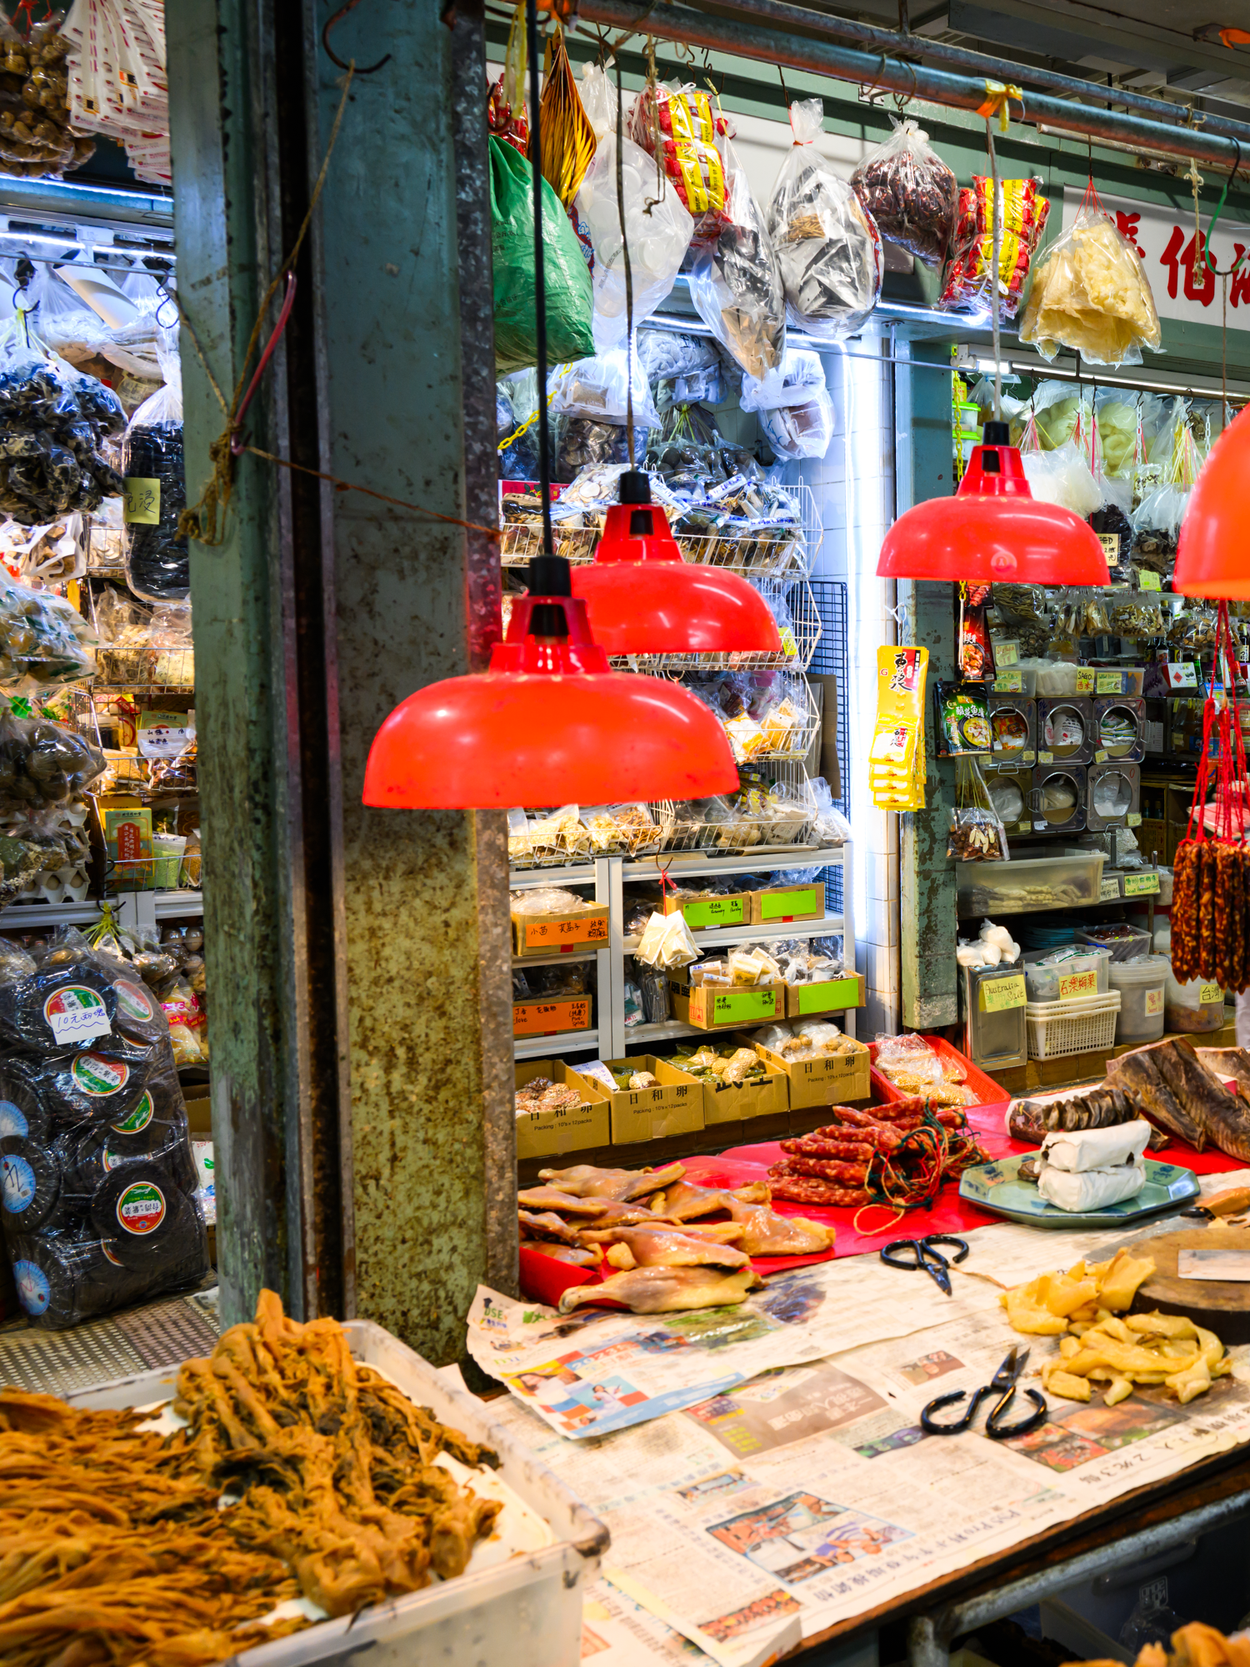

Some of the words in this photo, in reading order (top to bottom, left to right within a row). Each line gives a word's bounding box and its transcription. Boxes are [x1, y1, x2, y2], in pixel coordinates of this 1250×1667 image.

[985, 982, 1020, 996] Australia
[804, 1056, 855, 1074] 日和卵
[630, 1086, 688, 1105] 日和卵
[633, 1107, 651, 1115] Packing
[534, 1124, 554, 1132] Packing
